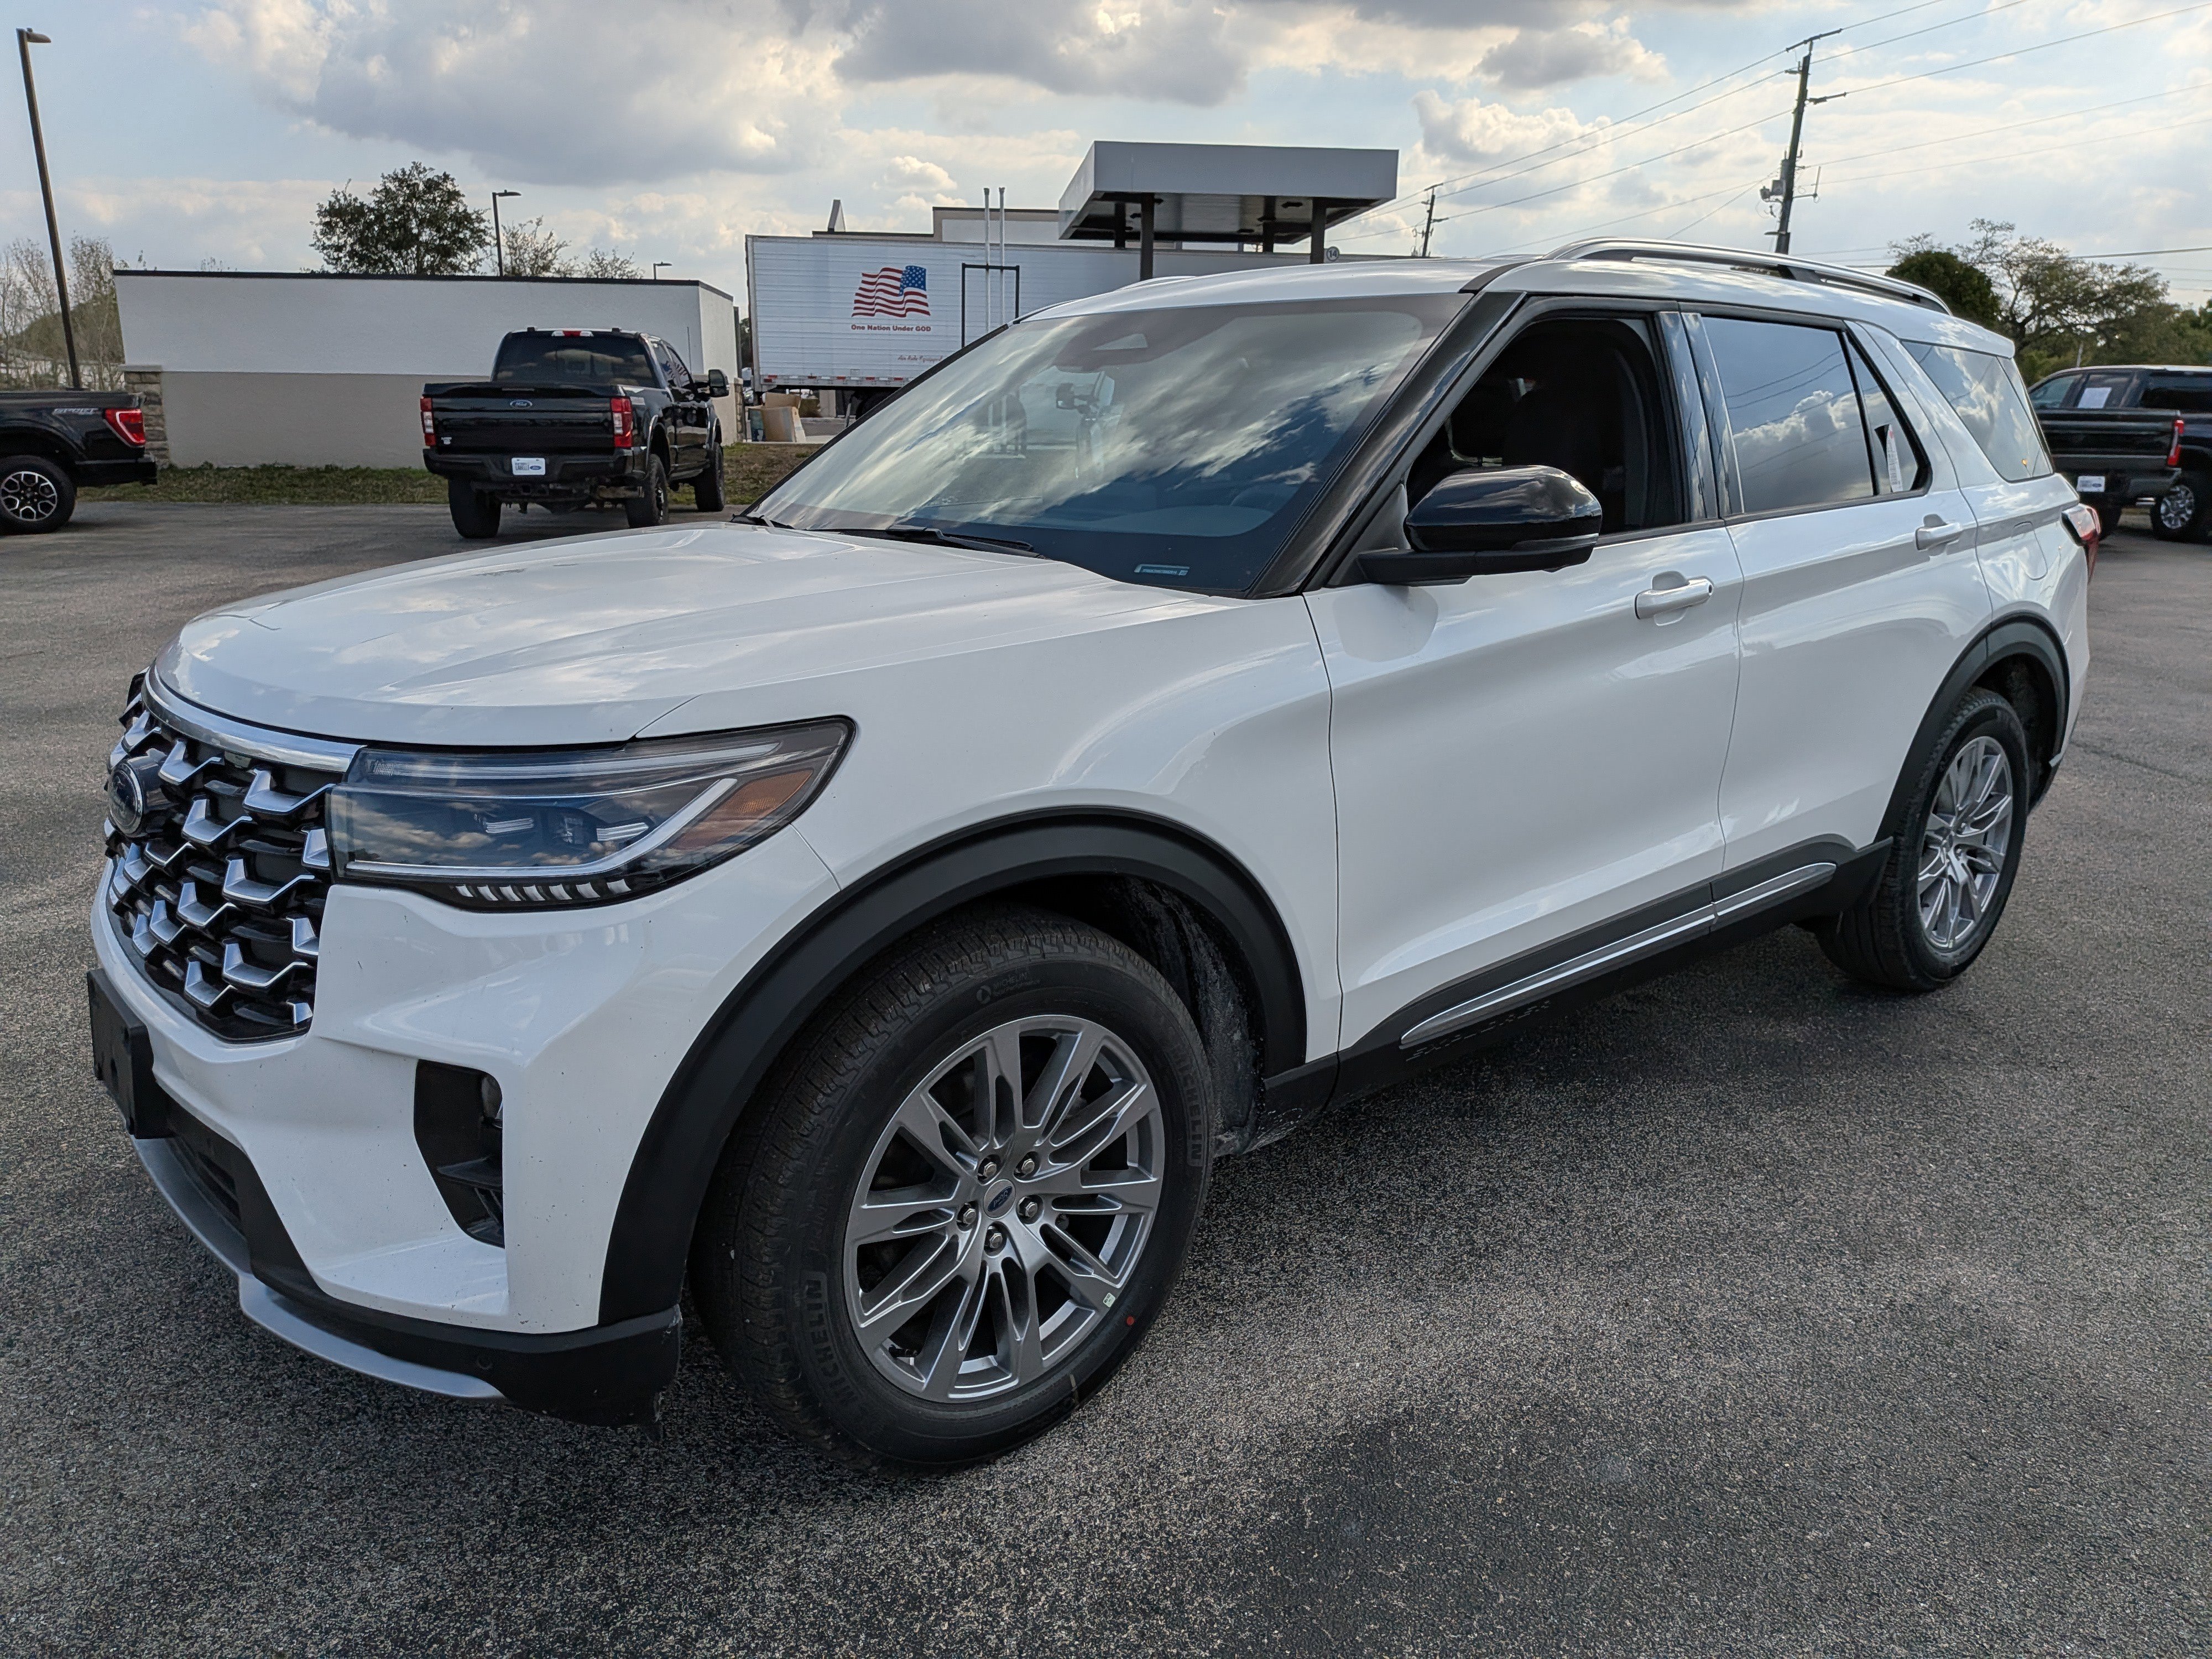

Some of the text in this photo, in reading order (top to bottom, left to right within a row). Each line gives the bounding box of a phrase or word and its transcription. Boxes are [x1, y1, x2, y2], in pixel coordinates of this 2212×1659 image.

[993, 972, 1027, 989] MICHELIN
[1170, 1045, 1202, 1160] MICHELIN
[806, 1279, 859, 1407] MICHELIN
